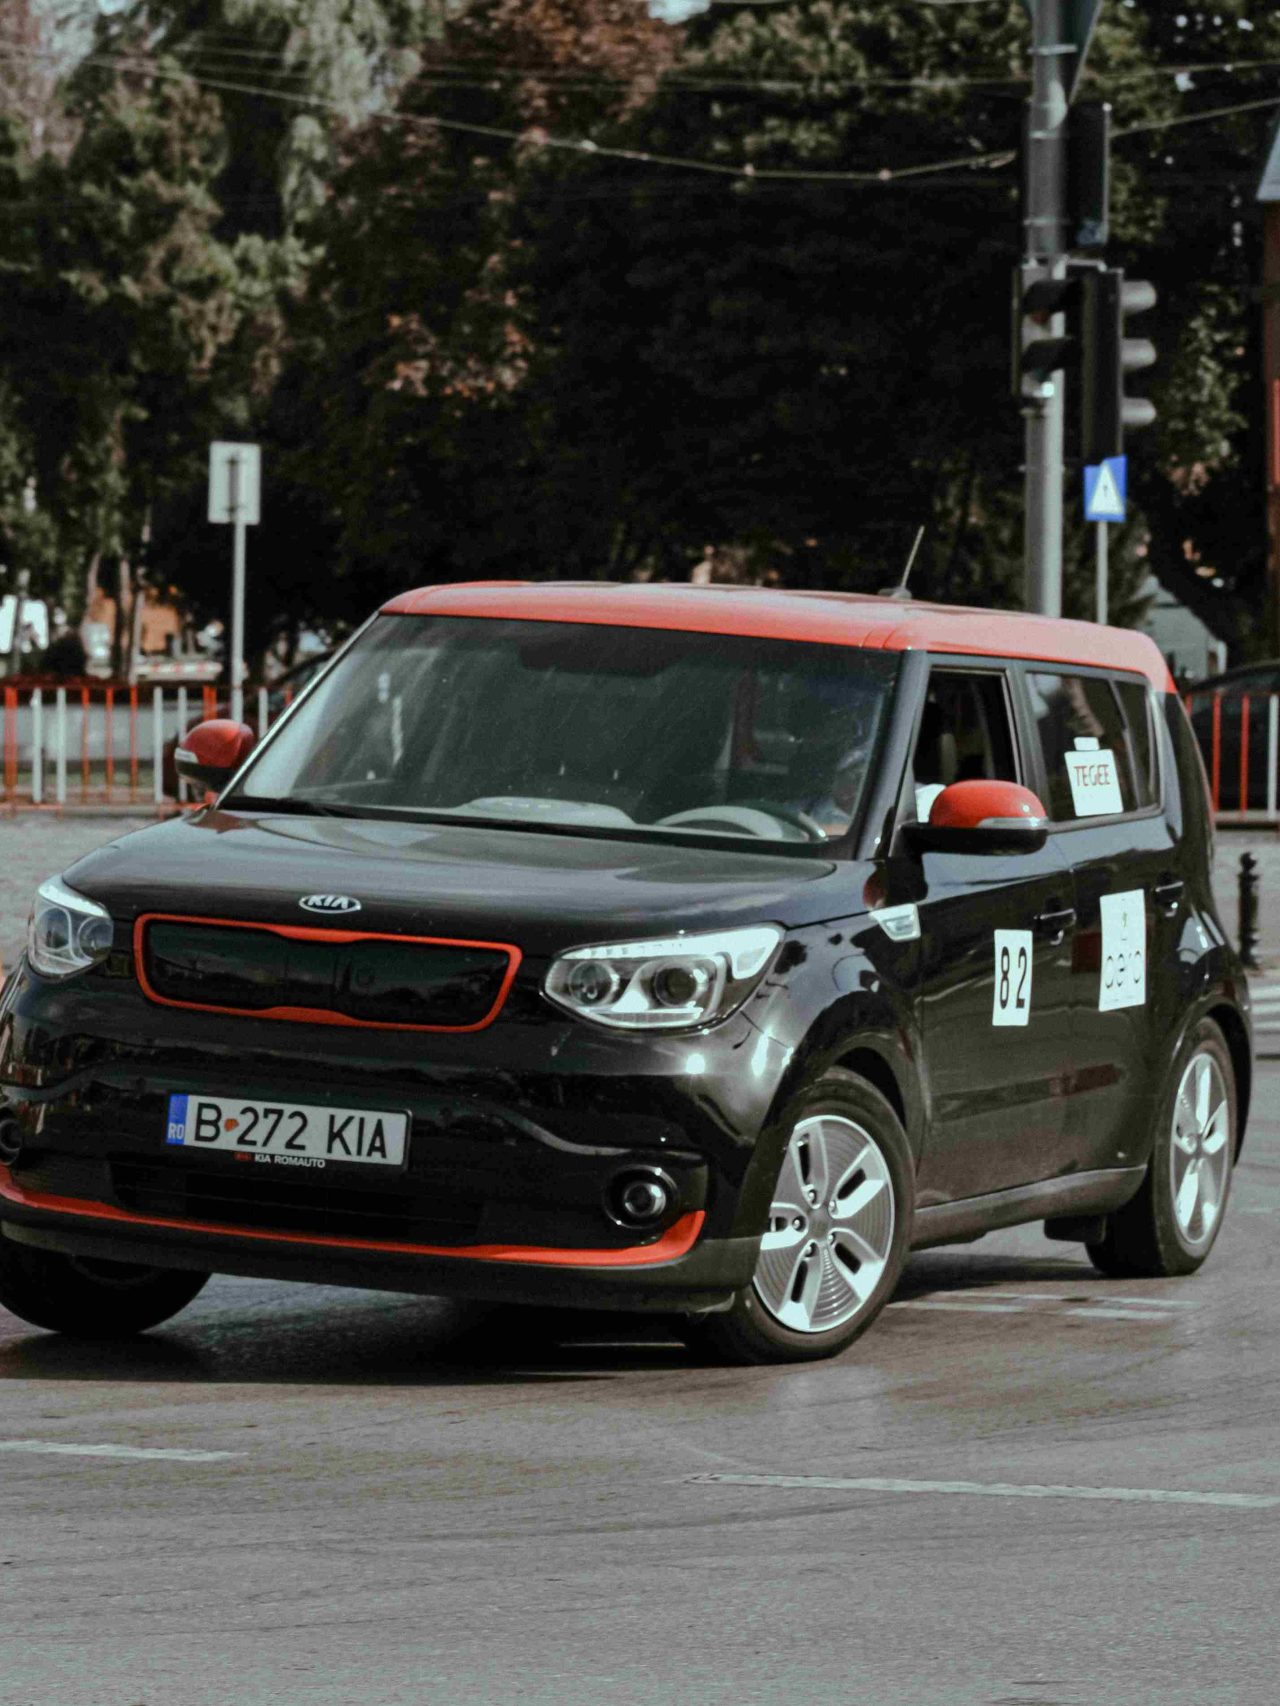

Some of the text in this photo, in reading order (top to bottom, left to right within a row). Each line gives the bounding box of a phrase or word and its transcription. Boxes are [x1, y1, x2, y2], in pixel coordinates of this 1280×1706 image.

[307, 894, 350, 910] KIA
[168, 1122, 185, 1140] RO
[194, 1102, 387, 1159] B 272 KIA
[254, 1153, 272, 1163] KIA
[274, 1155, 326, 1168] ROMAUTO
